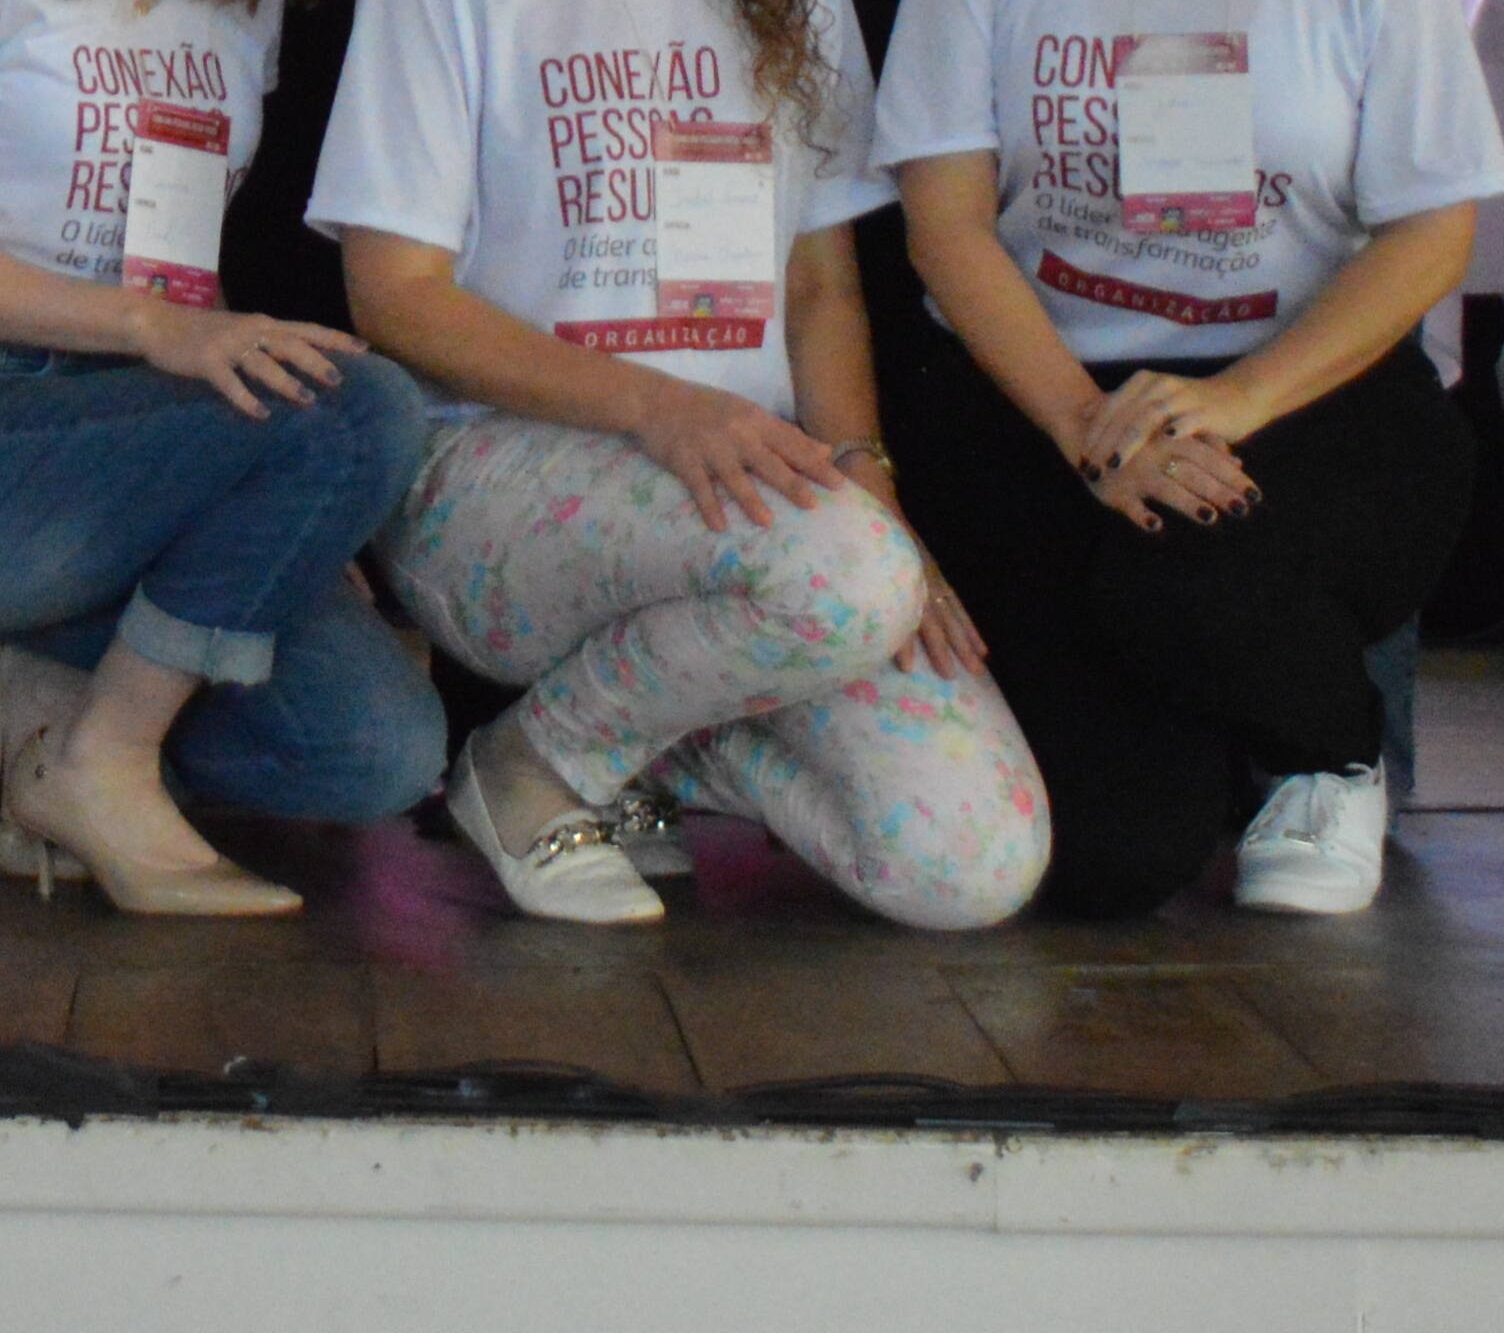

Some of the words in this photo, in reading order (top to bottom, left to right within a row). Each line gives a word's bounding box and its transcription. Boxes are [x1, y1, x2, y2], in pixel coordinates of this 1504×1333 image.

[73, 42, 228, 102] CONEXÃO
[539, 41, 720, 109] CONEXÃO
[61, 220, 81, 243] O
[56, 248, 88, 267] de
[563, 238, 579, 262] O
[581, 234, 636, 259] líder
[1074, 227, 1261, 278] transformação
[558, 266, 587, 291] de
[584, 326, 748, 350] ORGANIZAÇÃO
